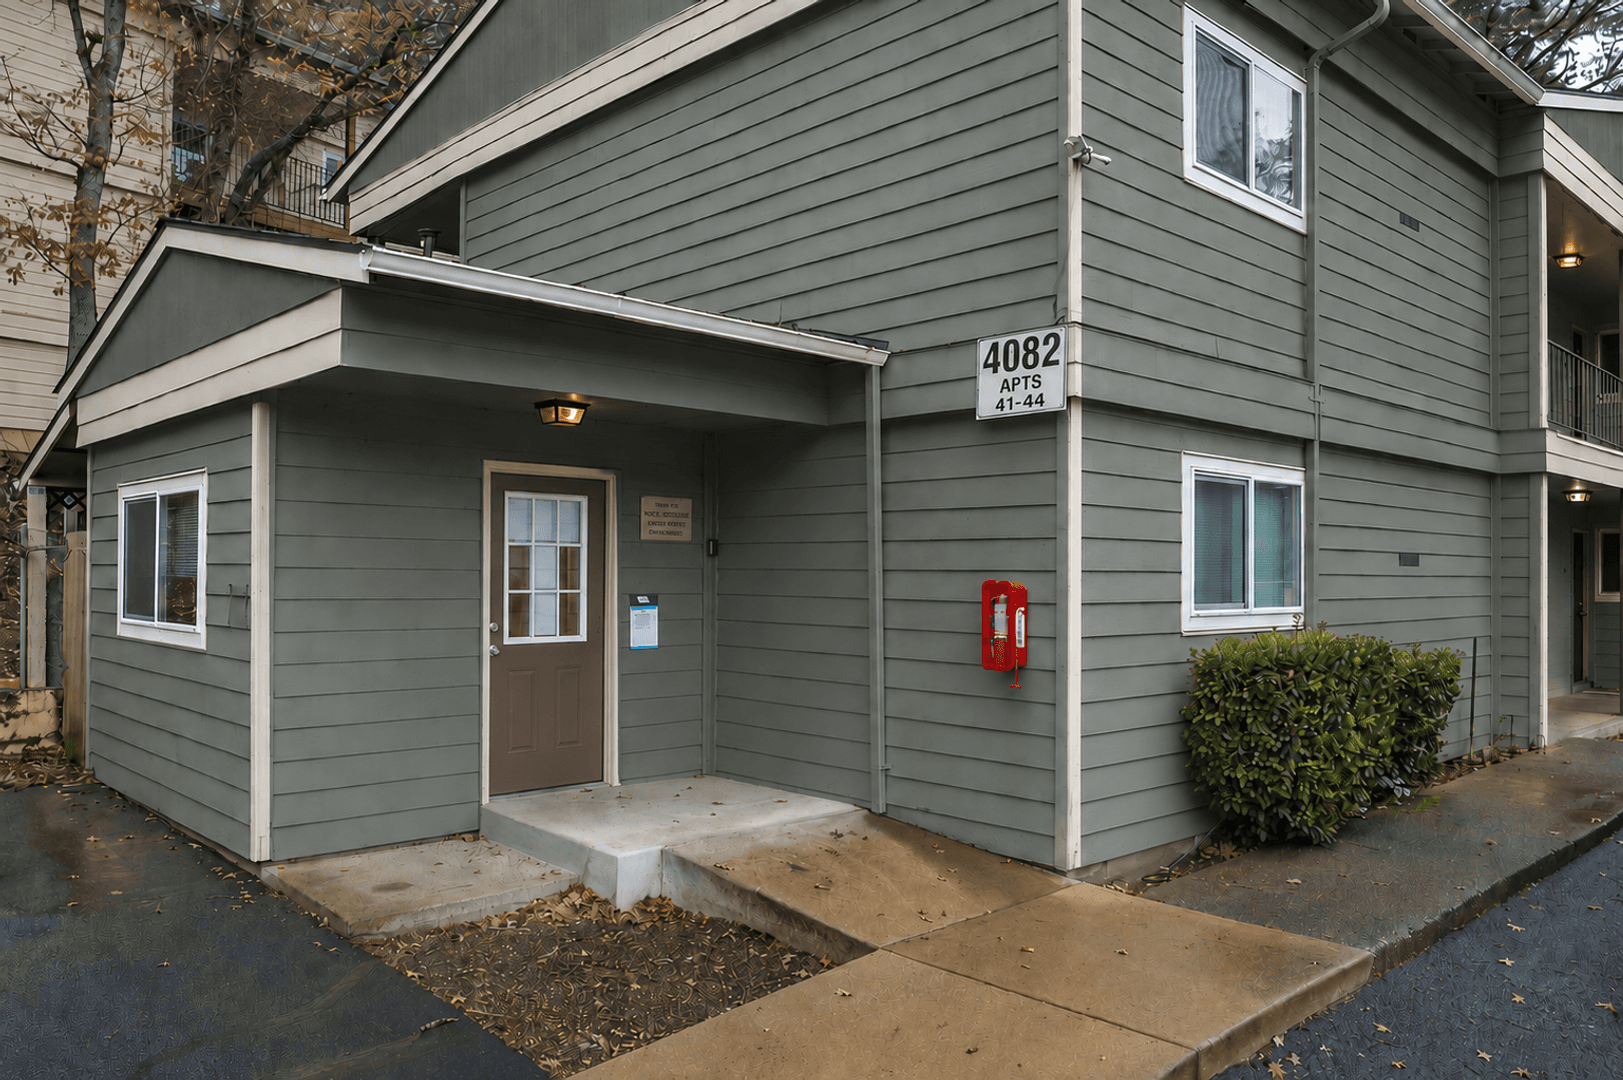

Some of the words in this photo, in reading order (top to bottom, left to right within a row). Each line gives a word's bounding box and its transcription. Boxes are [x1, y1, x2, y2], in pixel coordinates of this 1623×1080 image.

[983, 332, 1061, 374] 4082
[1000, 374, 1042, 393] APTS
[995, 393, 1045, 412] 41-44
